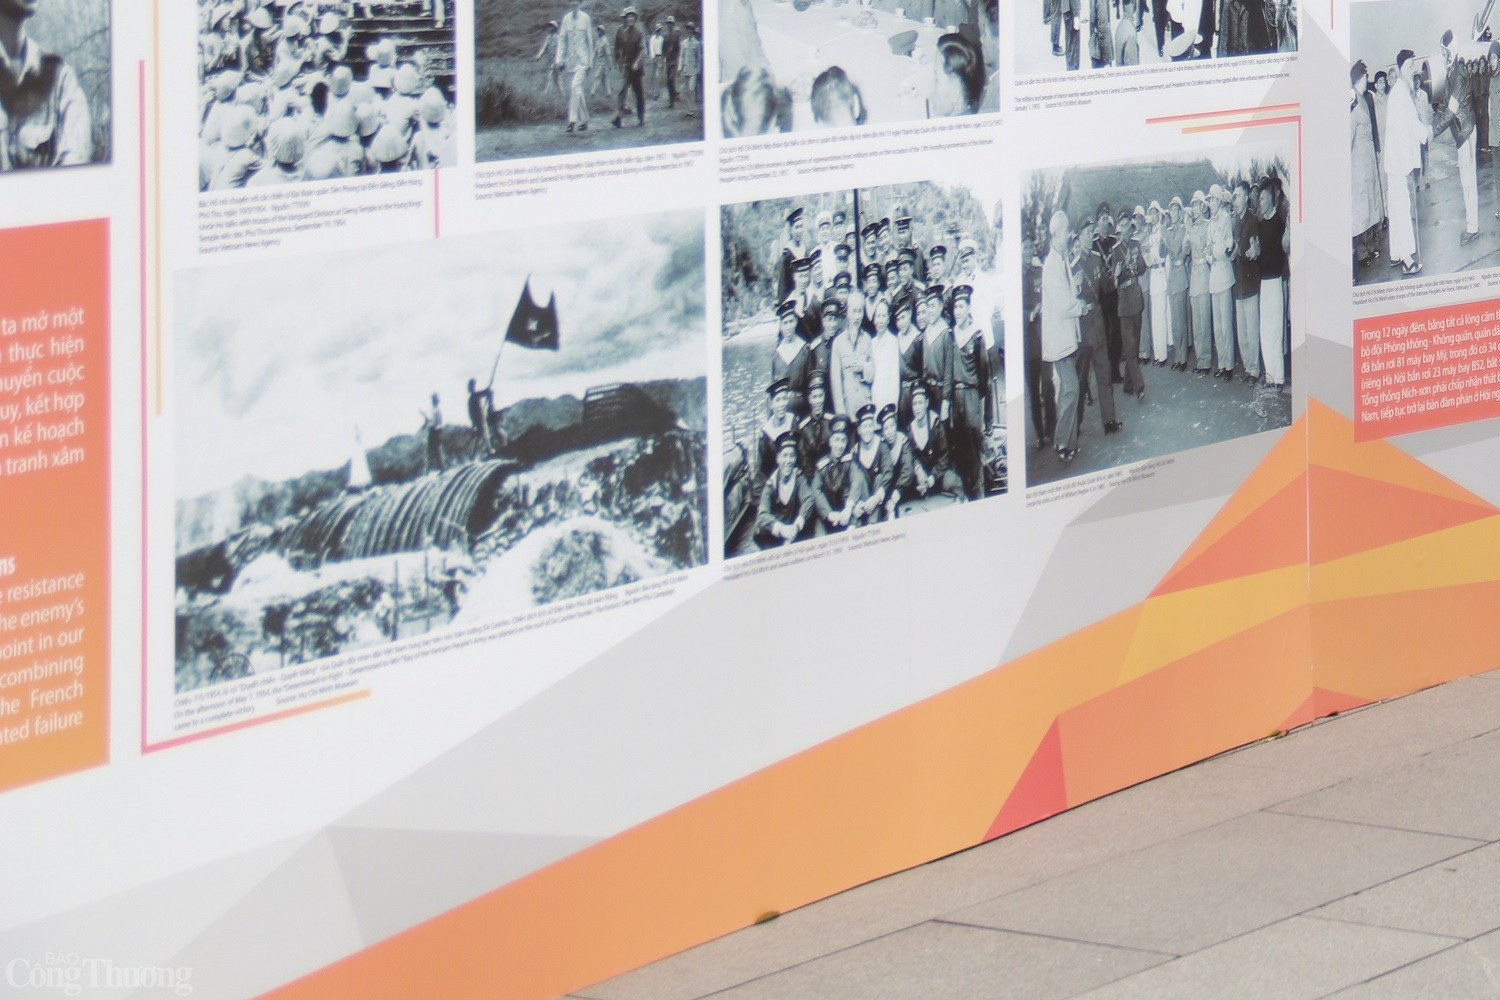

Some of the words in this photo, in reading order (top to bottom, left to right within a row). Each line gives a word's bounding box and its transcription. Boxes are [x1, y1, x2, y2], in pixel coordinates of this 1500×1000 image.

[2, 318, 17, 335] ta
[53, 305, 85, 330] một
[51, 334, 84, 358] hiện
[38, 416, 84, 442] hoạch
[7, 449, 48, 475] tranh
[8, 572, 85, 601] resistance
[39, 633, 52, 650] in
[58, 628, 85, 647] our
[0, 655, 84, 688] combining
[31, 680, 84, 708] French
[35, 710, 84, 736] failure
